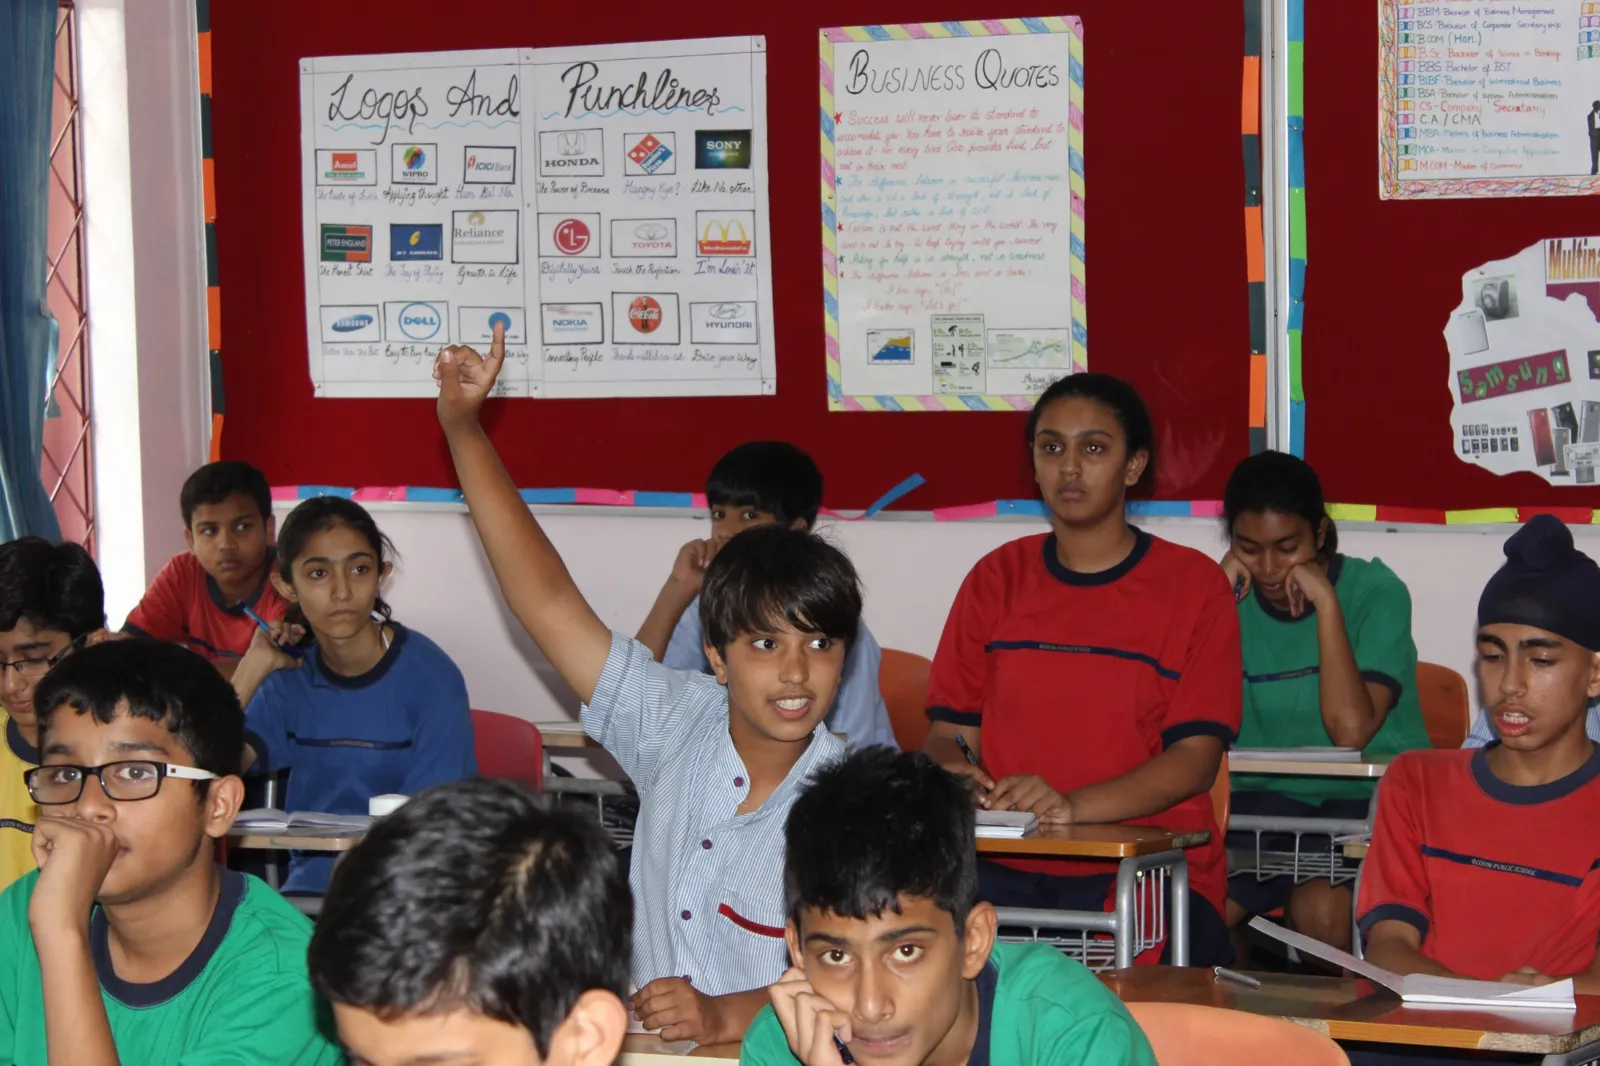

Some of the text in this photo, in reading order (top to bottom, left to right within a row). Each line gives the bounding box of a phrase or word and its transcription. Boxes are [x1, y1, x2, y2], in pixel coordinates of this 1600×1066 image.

[1512, 6, 1555, 18] Management
[846, 49, 1059, 94] BUSINESS QUOTES
[1418, 60, 1442, 72] BBS
[328, 61, 721, 145] Logos And Punchlines
[849, 110, 888, 125] Success
[896, 110, 915, 122] will
[1452, 114, 1481, 125] CMA
[706, 141, 742, 150] SONY
[475, 162, 512, 172] ICICI Bank
[544, 158, 600, 167] HONDA
[383, 187, 450, 206] Applying thought
[454, 227, 504, 239] Reliance
[327, 239, 367, 248] PETER ENGLAND
[694, 258, 717, 276] I'm
[404, 316, 436, 325] DELL
[706, 321, 752, 329] HYUNDAI
[580, 348, 604, 368] People
[1459, 356, 1566, 397] Samsung
